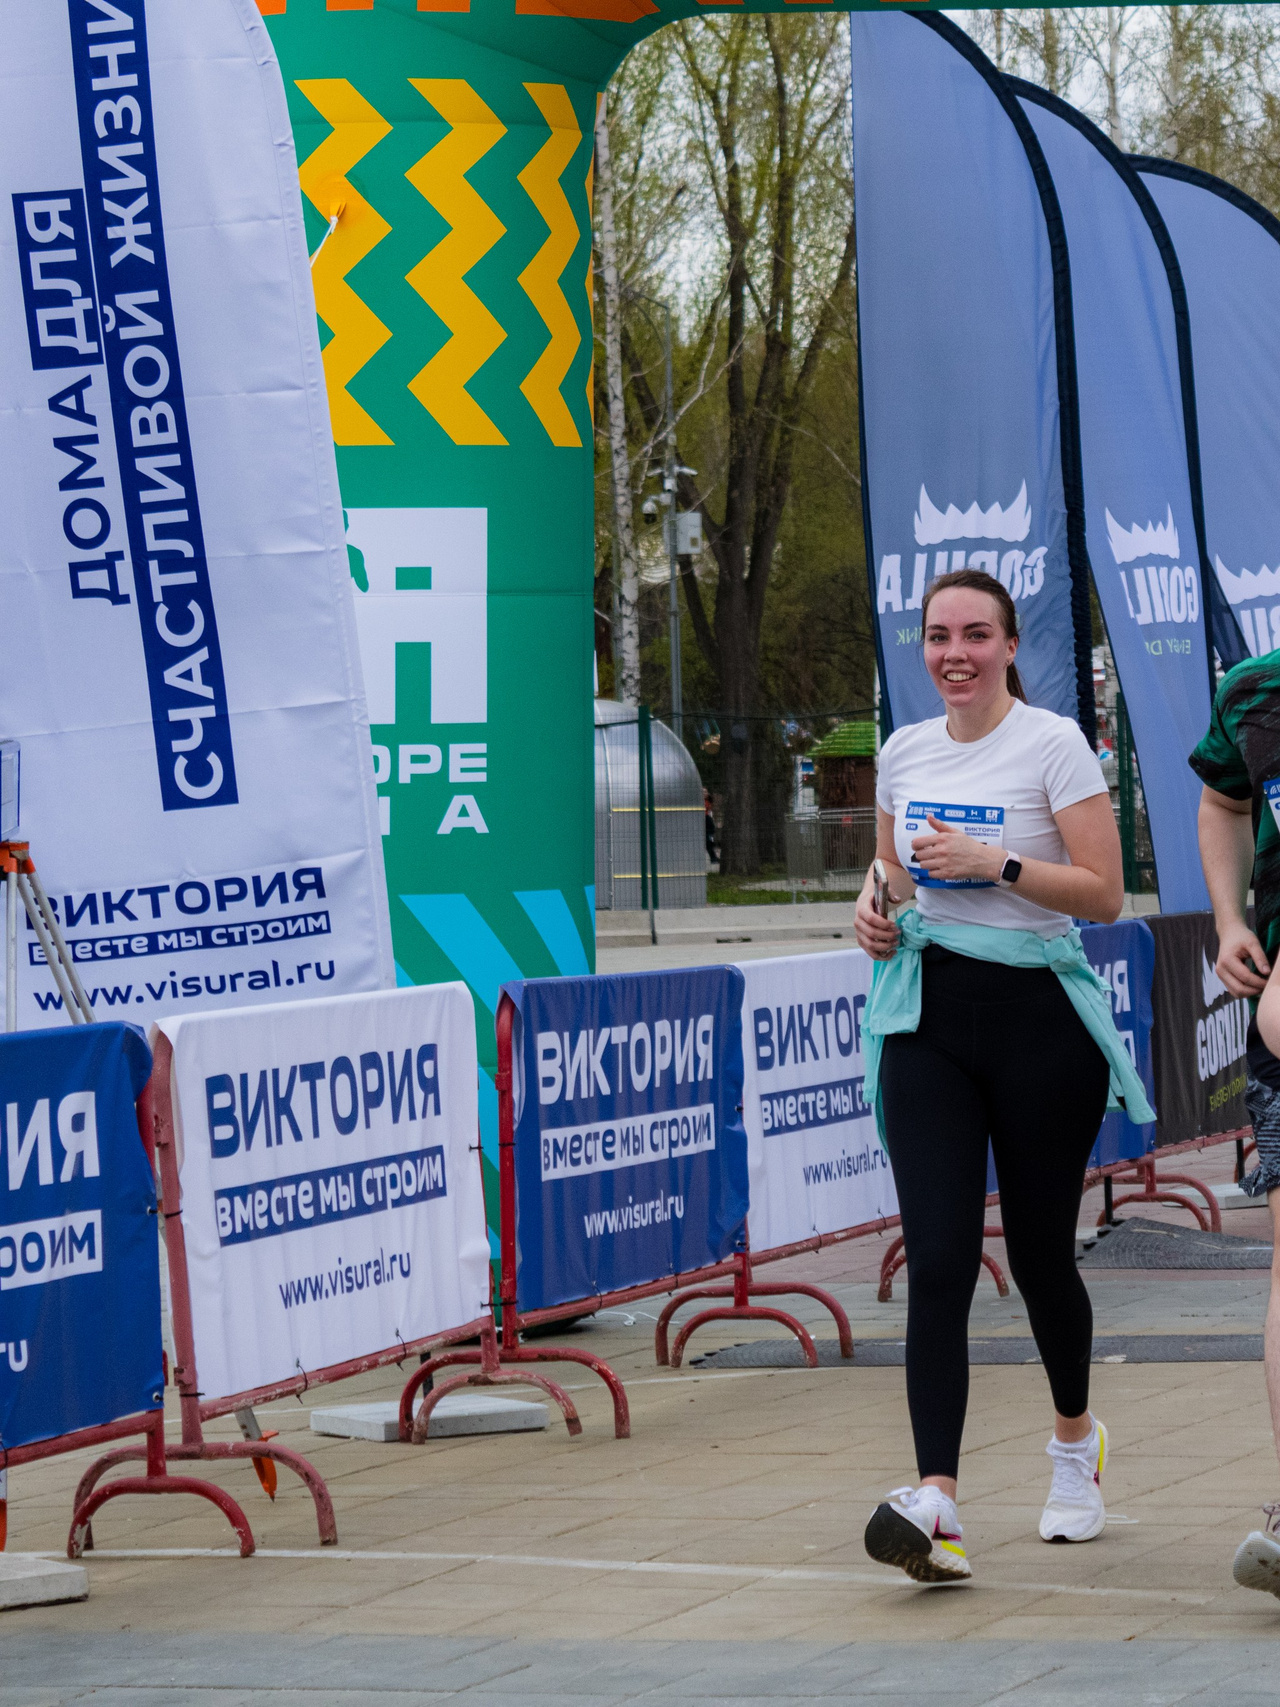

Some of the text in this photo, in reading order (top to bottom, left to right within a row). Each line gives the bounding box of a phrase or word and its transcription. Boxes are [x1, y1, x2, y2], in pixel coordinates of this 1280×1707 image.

[23, 198, 131, 606] ДОМА ДЛЯ
[102, 289, 224, 801] СЧАСТЛИВОЙ
[964, 826, 1001, 834] ВИКТОРИЯ
[157, 927, 203, 951] мы
[211, 913, 328, 946] строим
[536, 1014, 714, 1106] ВИКТОРИЯ
[204, 1043, 442, 1159] ВИКТОРИЯ
[762, 1089, 828, 1131] вместе
[829, 1084, 854, 1118] мы
[542, 1111, 712, 1172] вместе мы строим
[803, 1144, 888, 1187] www.visural.ru
[215, 1153, 444, 1238] вместе мы строим
[583, 1188, 685, 1239] www.visural.ru
[279, 1246, 412, 1310] www.visural.ru
